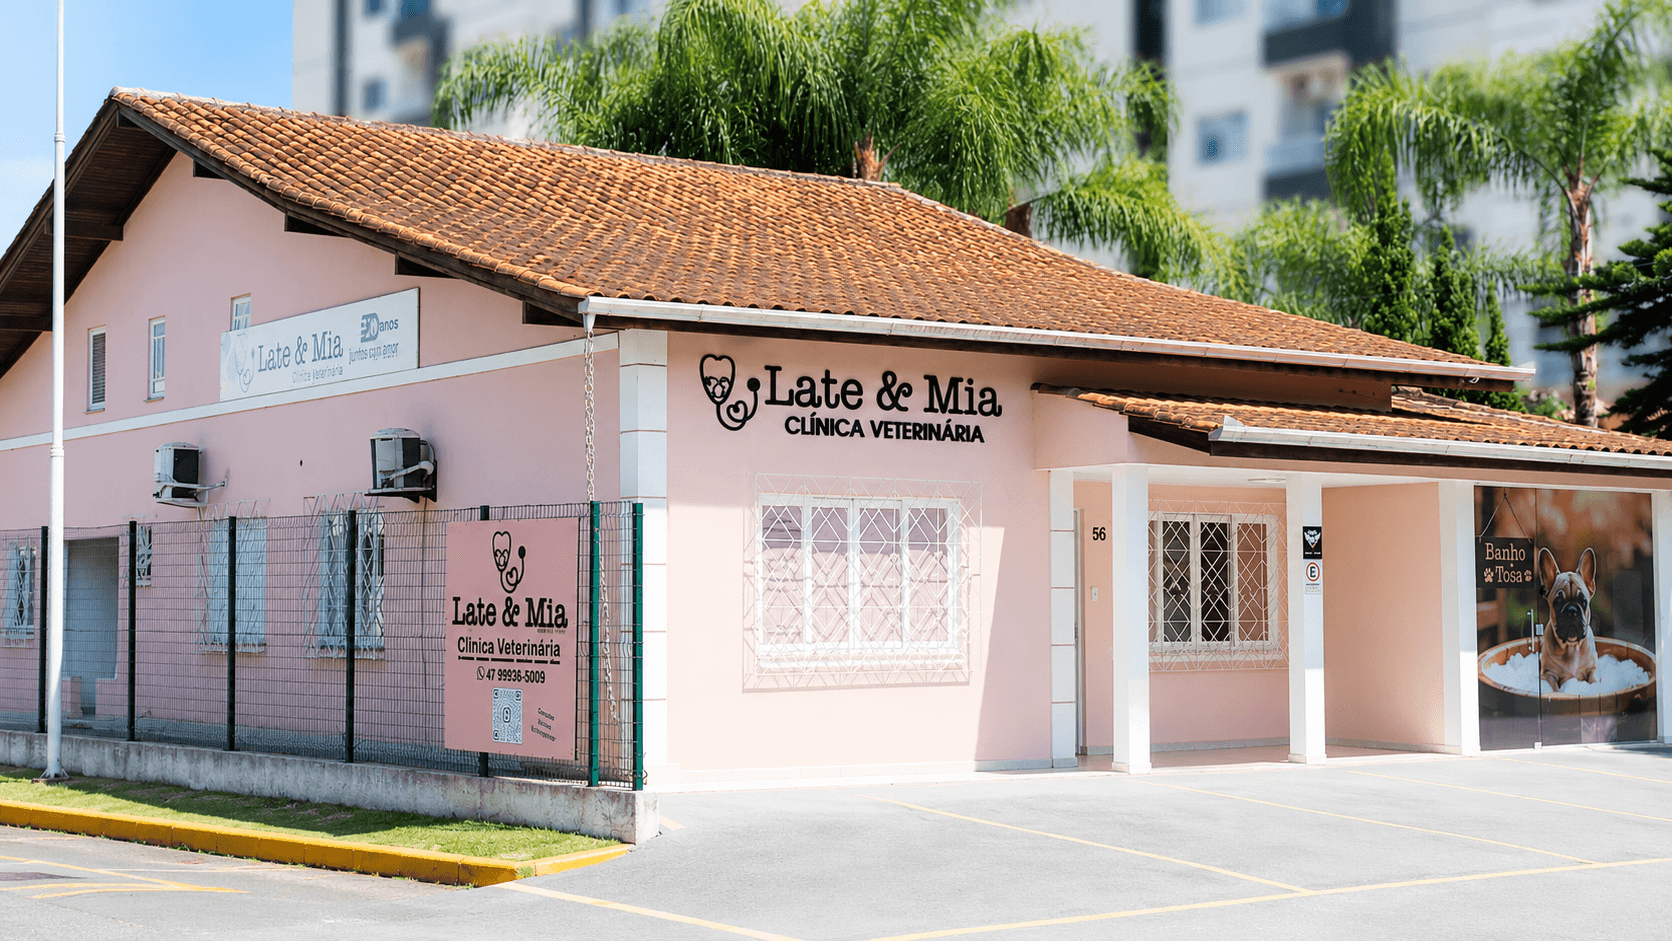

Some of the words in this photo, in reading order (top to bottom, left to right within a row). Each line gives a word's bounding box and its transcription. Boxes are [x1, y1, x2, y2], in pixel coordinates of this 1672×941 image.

[379, 319, 399, 332] anos
[258, 342, 291, 372] Late
[295, 336, 308, 365] &
[311, 331, 344, 362] Mia
[764, 365, 863, 410] Late
[876, 370, 913, 412] &
[923, 374, 1003, 417] Mia
[784, 411, 865, 438] CLÍNICA
[869, 418, 985, 443] VETERINÁRIA
[1092, 526, 1106, 541] 56
[1484, 542, 1526, 561] Banho
[1309, 566, 1316, 578] E
[1495, 565, 1523, 583] Tosa
[452, 596, 497, 626] Late
[502, 596, 520, 627] &
[524, 597, 568, 628] Mia
[497, 638, 561, 657] Veterinária
[486, 668, 496, 681] 47
[497, 668, 546, 684] 99936-5009
